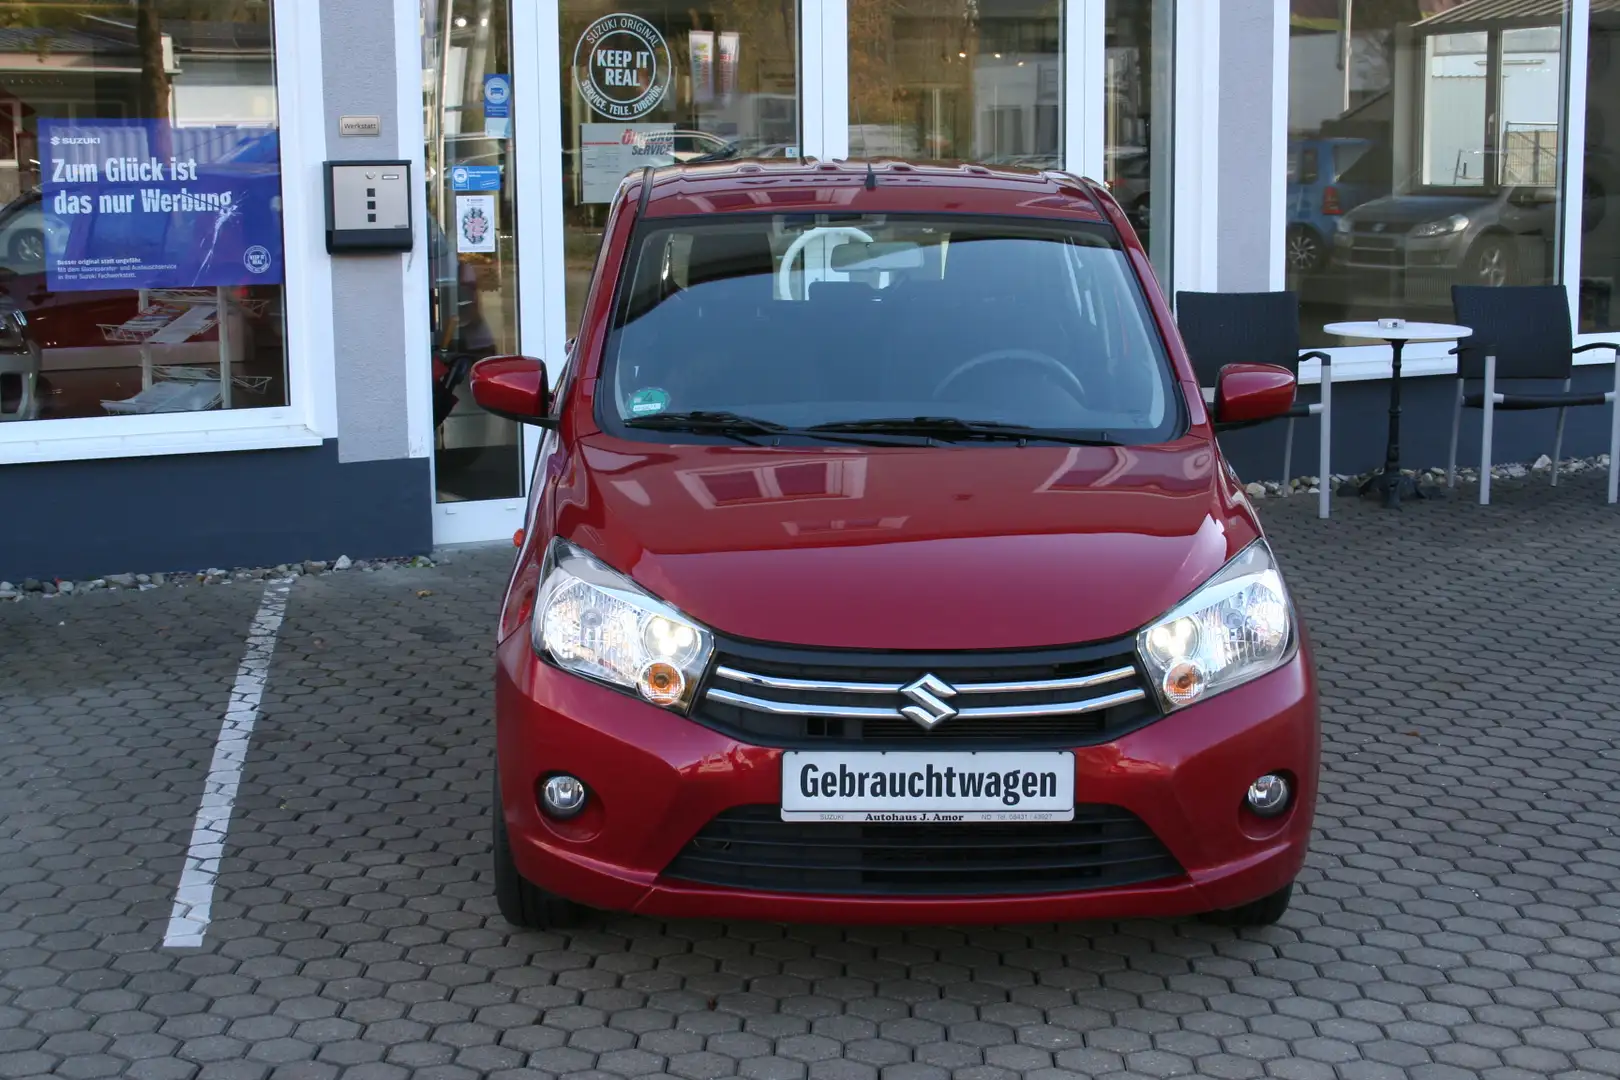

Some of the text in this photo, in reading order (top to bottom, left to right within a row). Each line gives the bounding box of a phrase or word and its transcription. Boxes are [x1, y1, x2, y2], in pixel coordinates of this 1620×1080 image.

[586, 18, 659, 48] SUZUKI ORIGINAL
[597, 49, 650, 69] KEEP IT
[605, 68, 641, 87] REAL
[581, 79, 664, 116] SERVICE. TEILE. ZUBEHÖR.
[61, 137, 101, 145] SUZUKI
[51, 156, 198, 183] Zum Glück ist
[54, 188, 232, 216] das nur Werbung
[800, 763, 1057, 806] Gebrauchtwagen
[865, 813, 918, 821] Autohaus
[919, 813, 930, 821] J.
[932, 813, 964, 821] Amor
